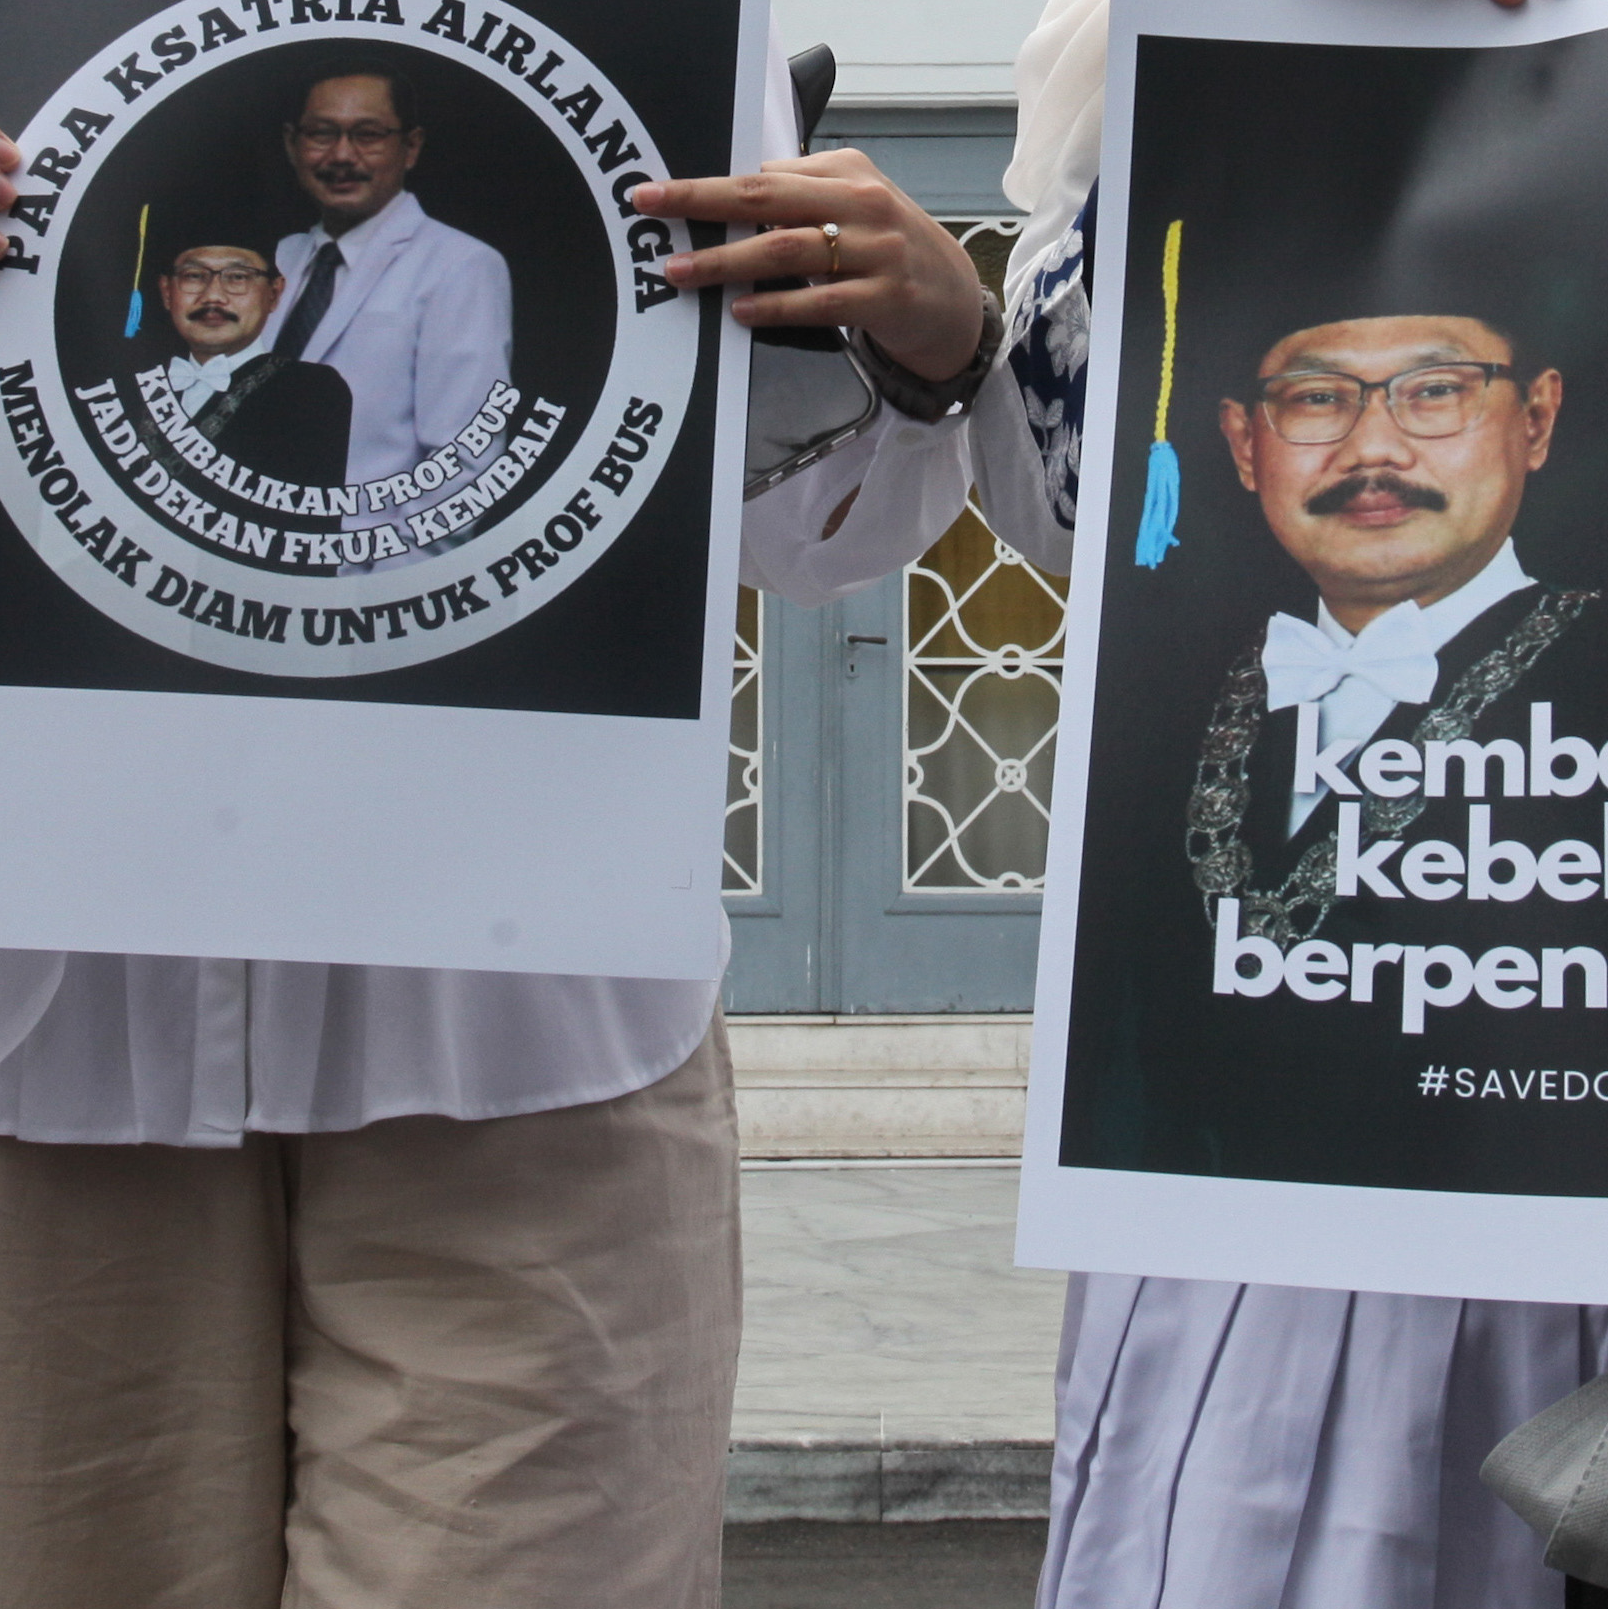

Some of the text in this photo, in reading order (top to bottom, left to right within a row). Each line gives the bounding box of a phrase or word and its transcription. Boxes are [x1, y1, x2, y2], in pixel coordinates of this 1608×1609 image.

[75, 378, 567, 565] JADI DEKAN FKUA KEMBALI
[135, 364, 521, 516] KEMBALIKAN PROF BUS
[146, 565, 292, 644] DIAM
[302, 575, 490, 645] UNTUK
[486, 487, 603, 598] PROF
[589, 396, 663, 497] BUS
